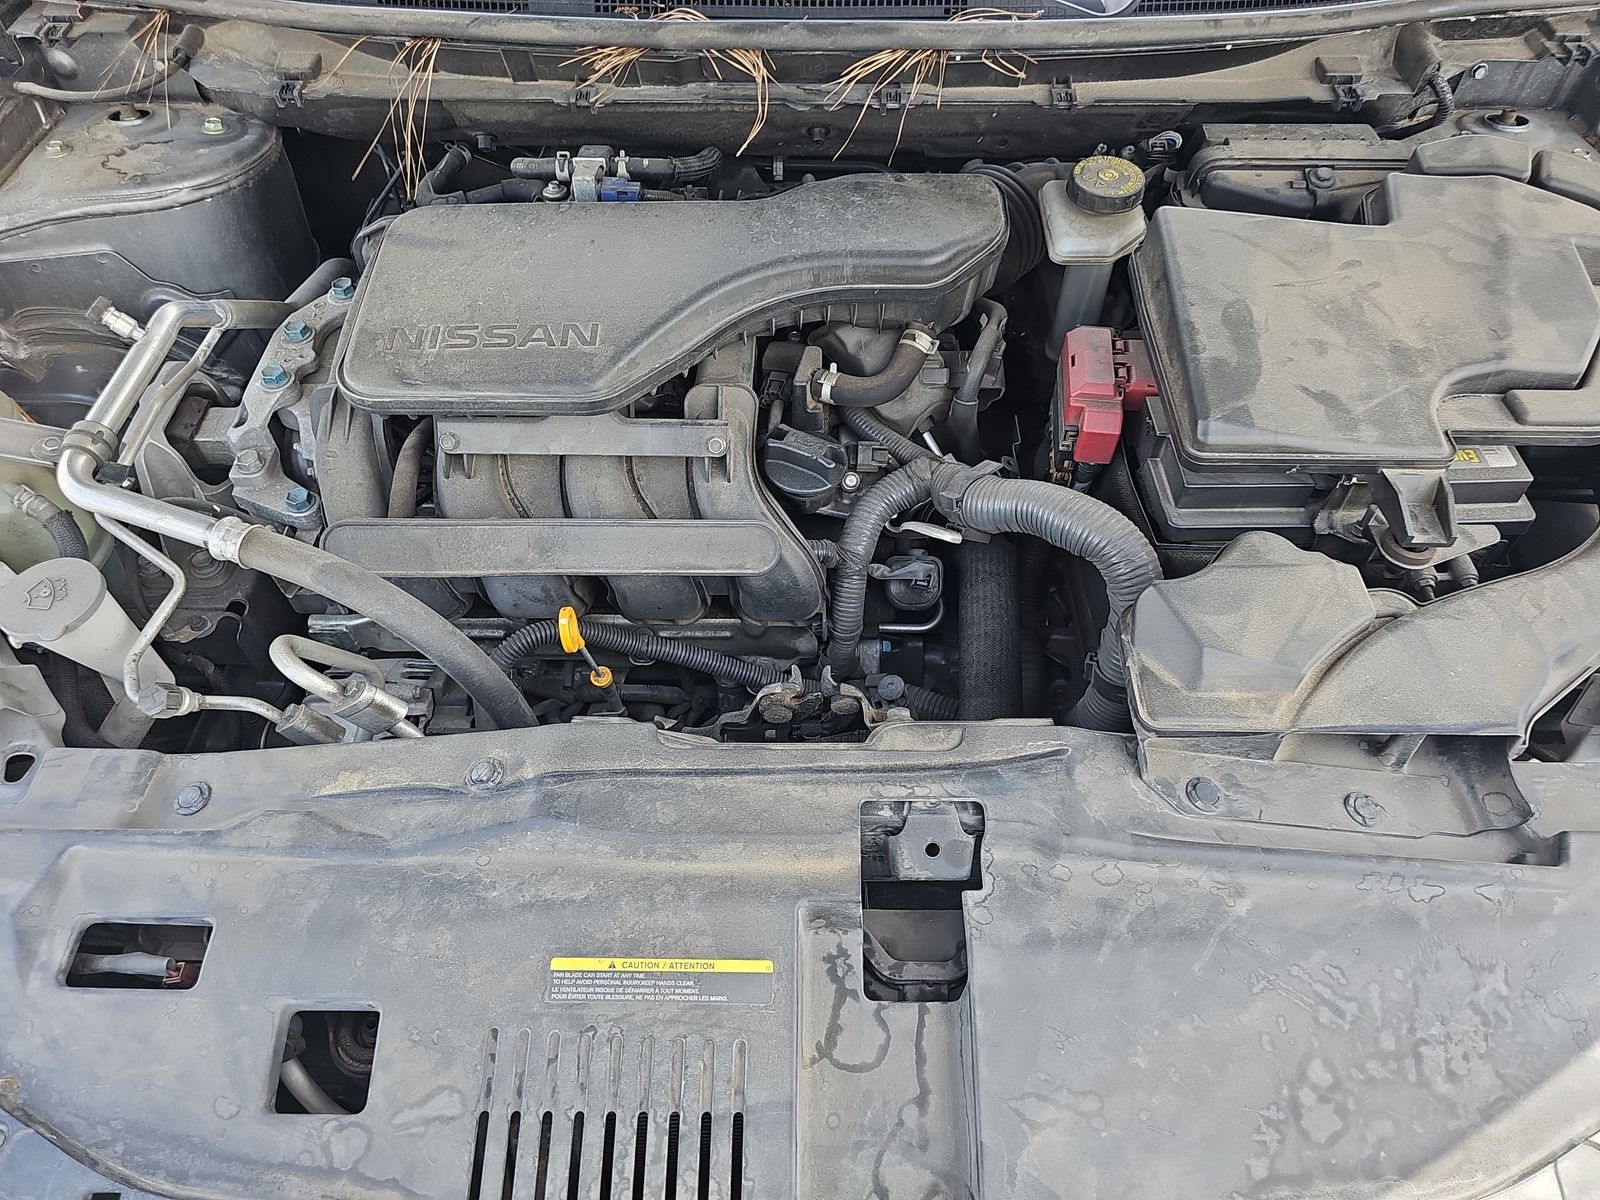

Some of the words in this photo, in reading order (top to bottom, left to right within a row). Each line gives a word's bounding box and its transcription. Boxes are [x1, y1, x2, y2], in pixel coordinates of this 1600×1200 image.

[384, 322, 600, 350] NISSAN
[621, 961, 660, 969] CAUTION
[668, 962, 715, 970] ATTENTION
[625, 986, 655, 994] DÉMARRER
[568, 992, 586, 1000] ÉVITER
